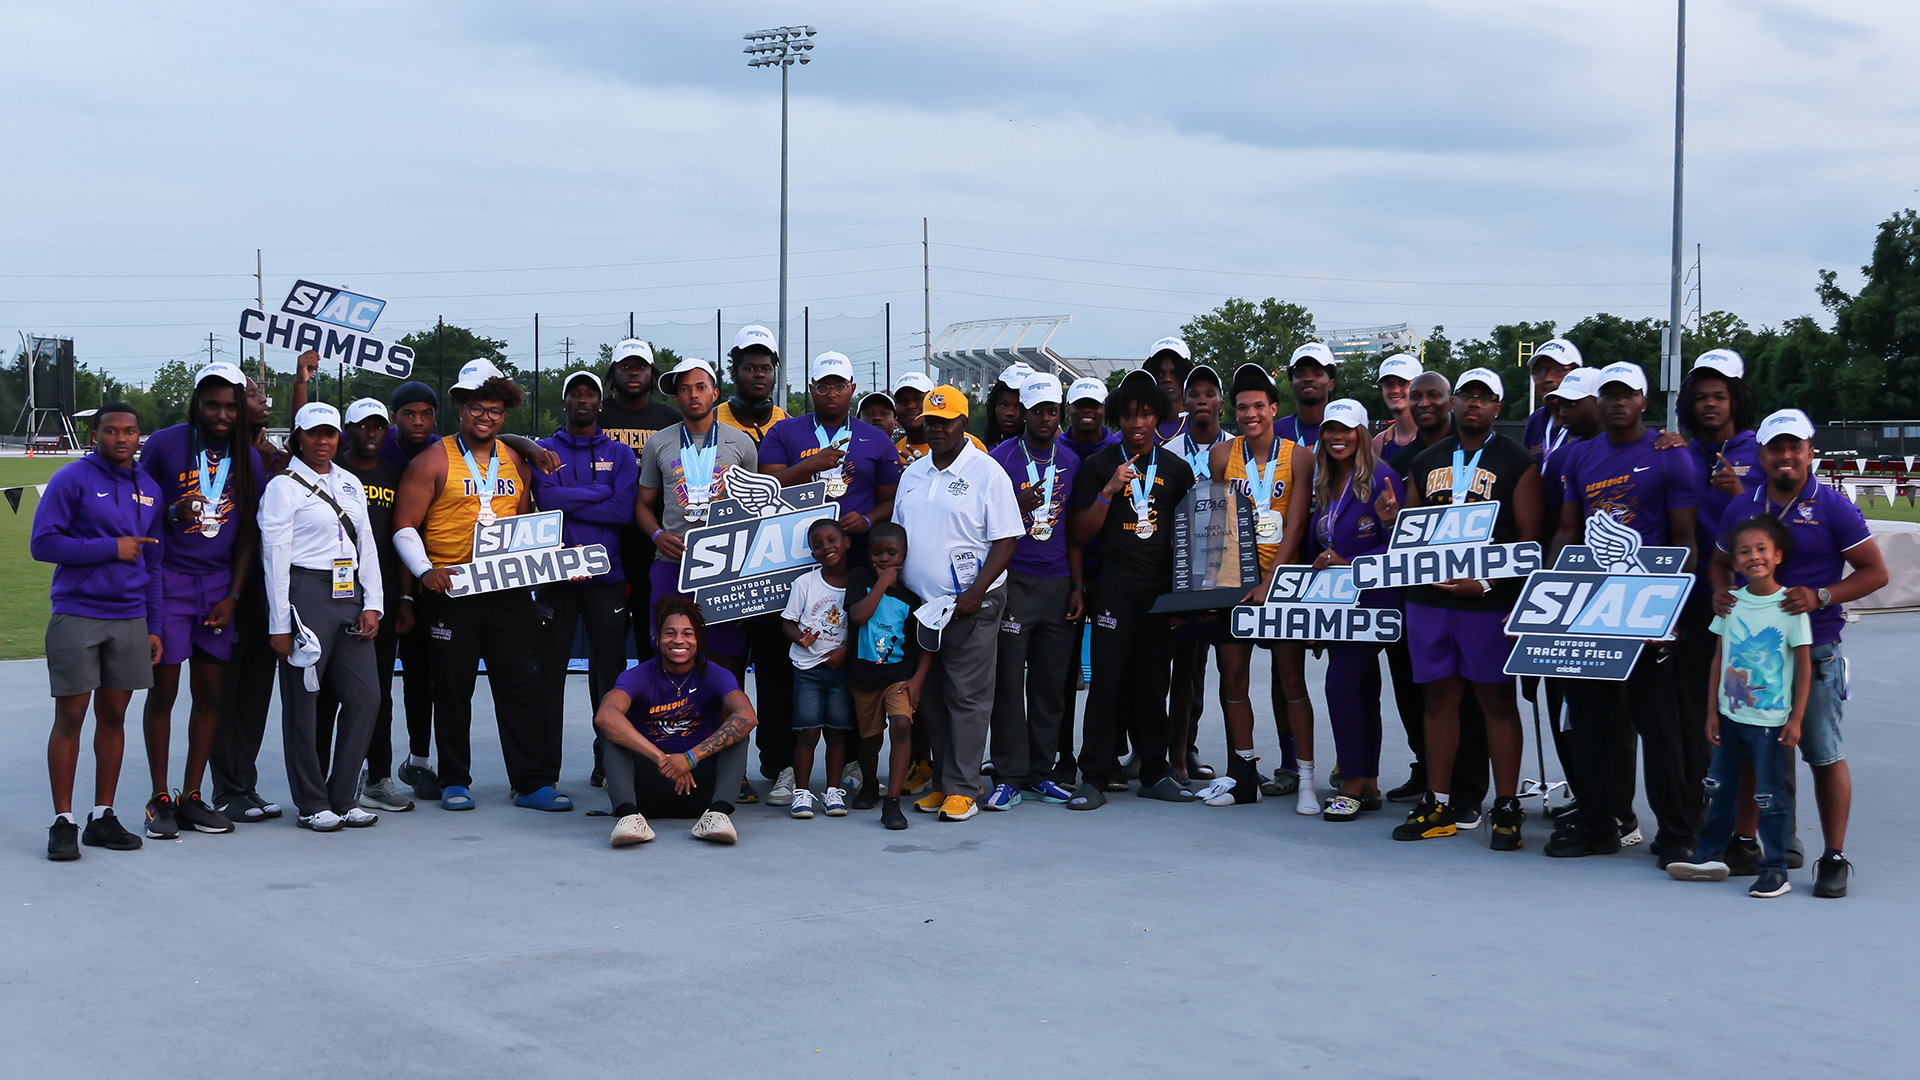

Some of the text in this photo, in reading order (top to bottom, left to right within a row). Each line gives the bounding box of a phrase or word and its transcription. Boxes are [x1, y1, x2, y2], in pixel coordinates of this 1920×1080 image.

[287, 285, 380, 328] SIAC
[238, 308, 414, 378] CHAMPS
[718, 491, 815, 516] 20 25
[1195, 499, 1228, 512] SIAC
[477, 513, 496, 521] SIAC
[1257, 523, 1276, 533] SIAC
[1396, 508, 1492, 544] SIAC
[479, 517, 558, 553] SIAC
[446, 545, 611, 597] CHAMPS
[1353, 542, 1541, 588] CHAMPS
[1568, 554, 1674, 565] 20 25
[706, 582, 791, 606] TRACK & FIEL
[731, 579, 771, 592] OUTDOOR
[1272, 571, 1355, 599] SIAC
[716, 593, 786, 612] CHAMPIONSHIP
[741, 603, 765, 614] cricket
[1517, 581, 1681, 629] SIAC
[1231, 607, 1401, 641] CHAMPS
[1526, 647, 1623, 660] TRACK & FIELD
[1554, 640, 1597, 648] OUTDOOR
[1532, 658, 1606, 666] CHAMPIONSHIP
